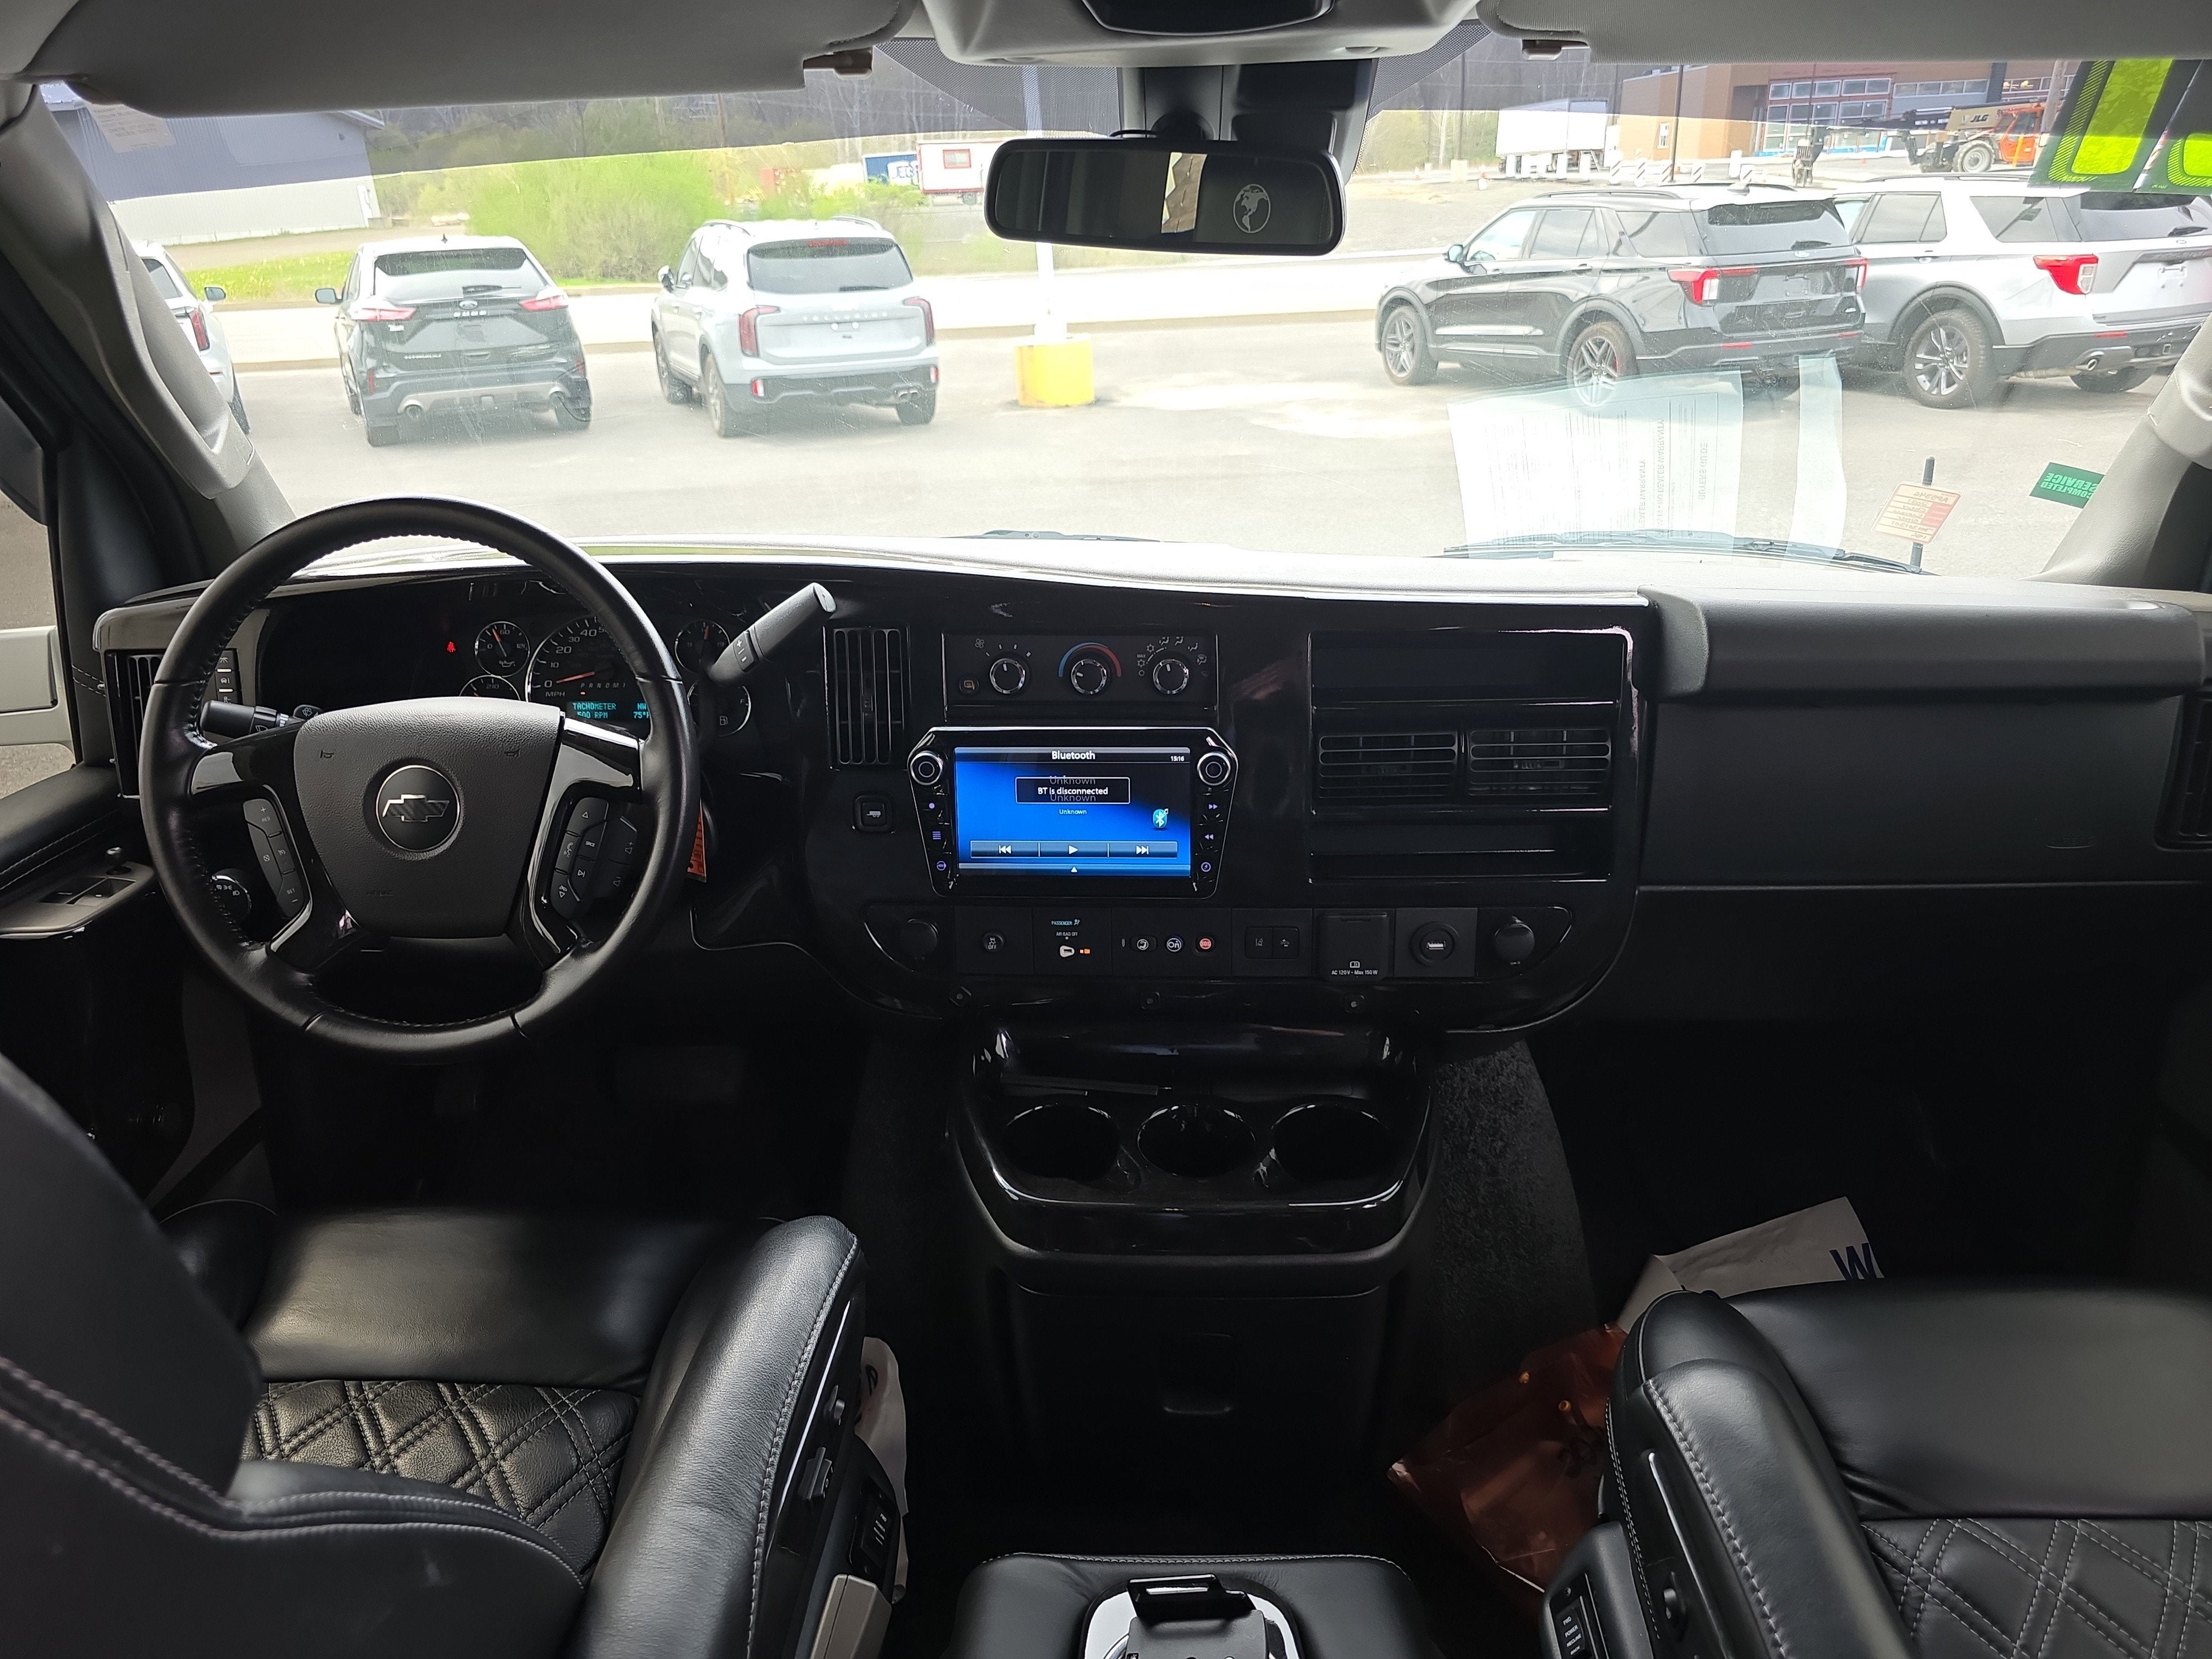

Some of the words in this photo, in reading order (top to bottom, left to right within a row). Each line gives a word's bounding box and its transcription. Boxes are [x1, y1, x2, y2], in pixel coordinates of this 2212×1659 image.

[1970, 114, 1990, 123] JLG
[1051, 750, 1096, 760] Bluetooth
[1050, 775, 1096, 785] Unknown
[1056, 787, 1109, 795] disconnected
[1050, 793, 1096, 802] Unknown
